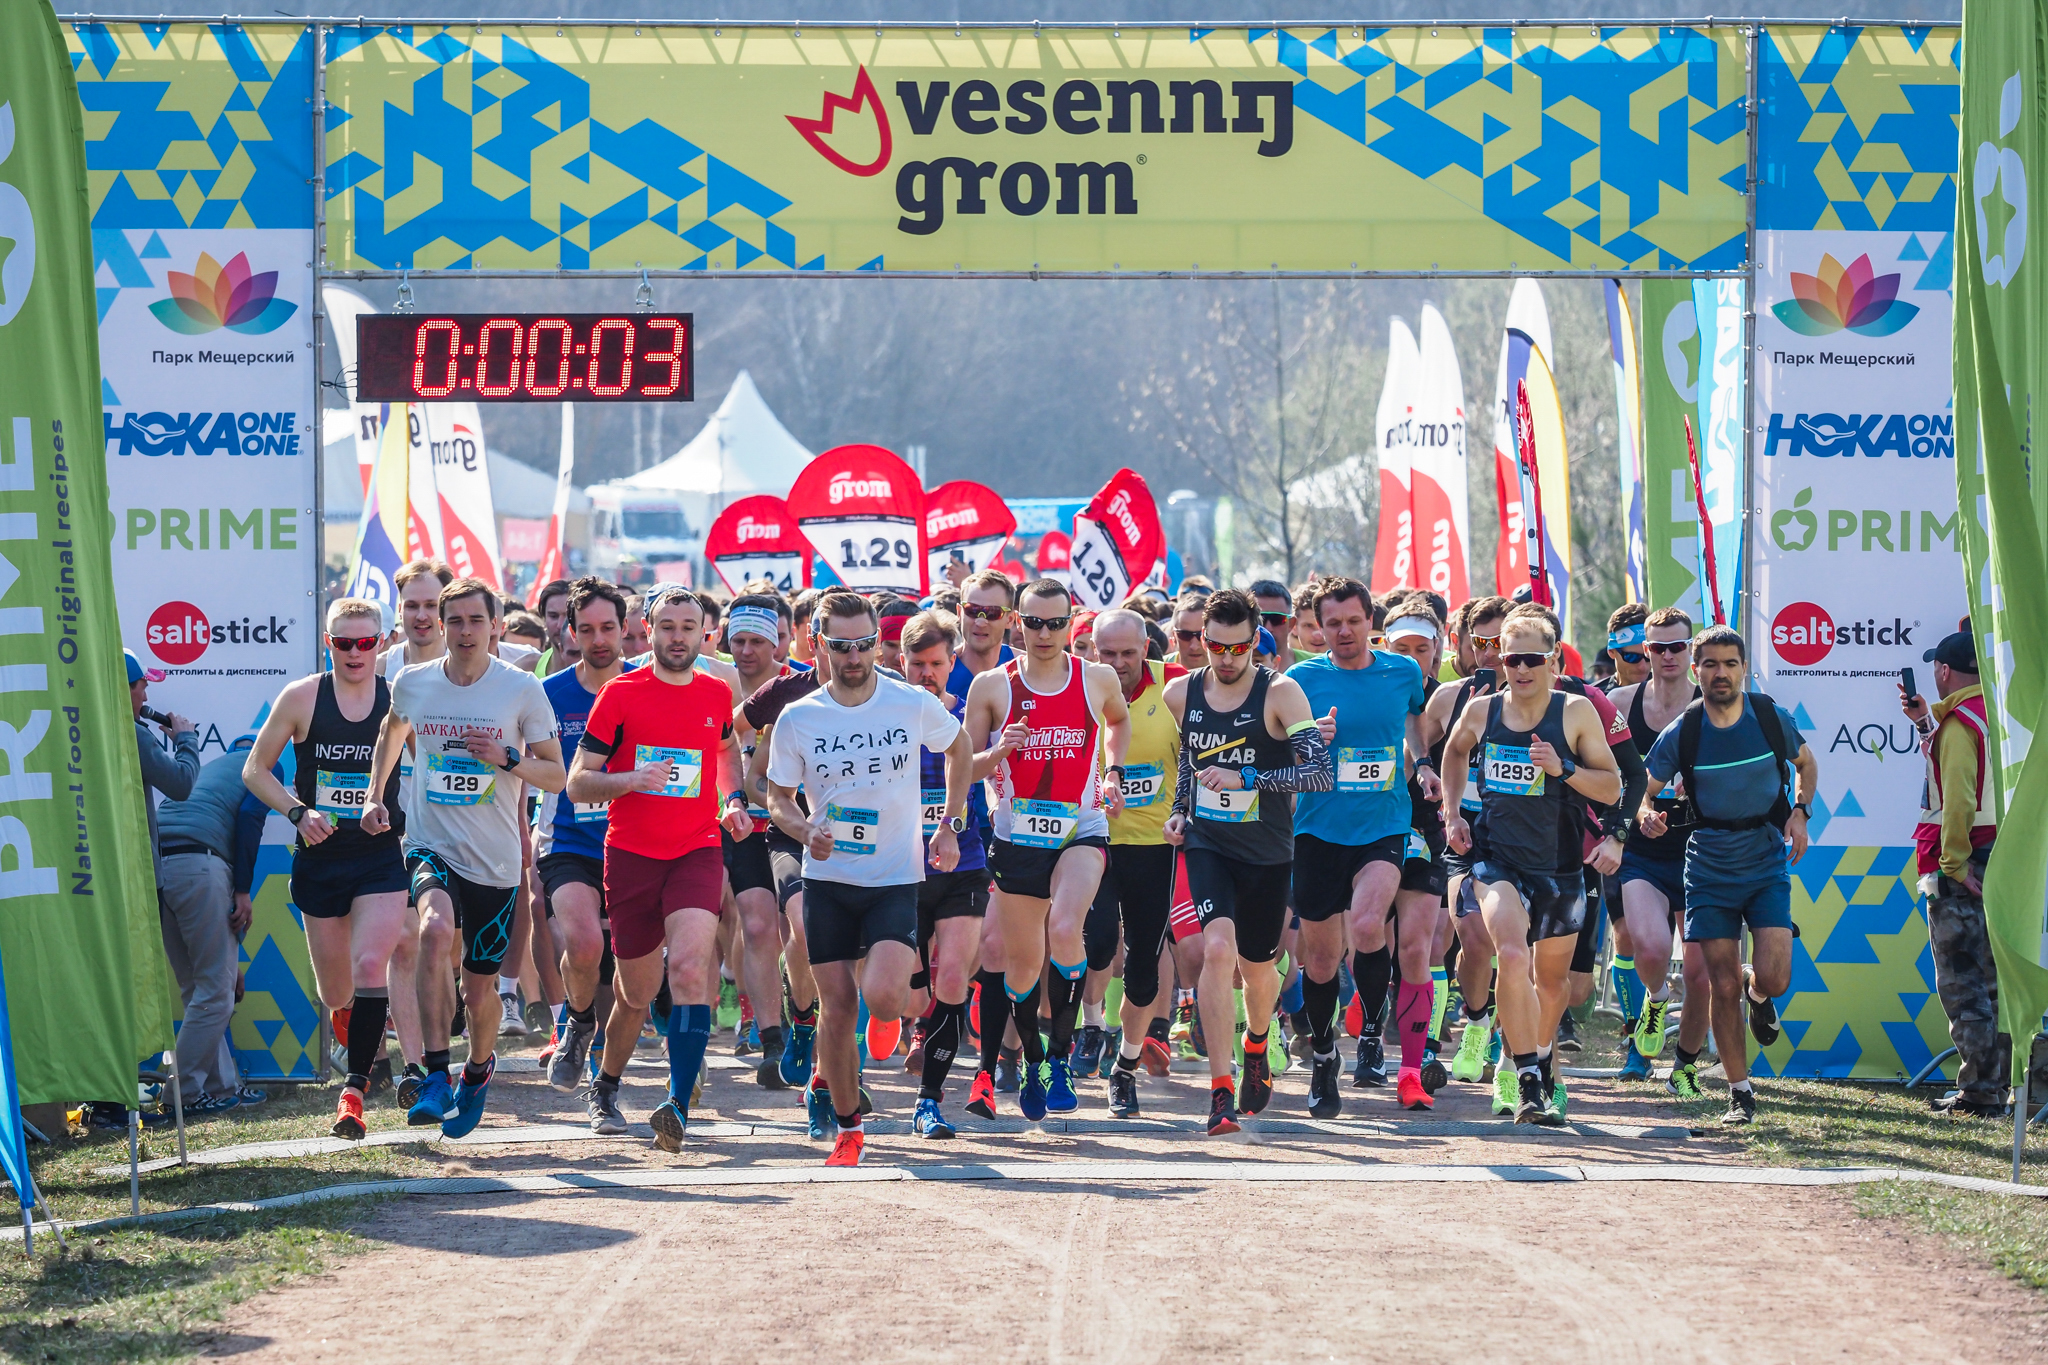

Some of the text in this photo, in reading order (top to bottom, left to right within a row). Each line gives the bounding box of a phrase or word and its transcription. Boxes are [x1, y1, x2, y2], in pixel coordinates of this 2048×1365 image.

[895, 157, 1138, 235] grom
[152, 350, 294, 366] Парк Мещерский
[413, 319, 684, 396] 0:00:03
[1774, 351, 1915, 367] Парк Мещерский
[103, 412, 296, 456] HOKA ONE
[1763, 413, 1954, 458] HOKA ON
[242, 435, 300, 456] ONE
[1910, 436, 1954, 458] ON
[829, 478, 892, 504] grom
[127, 509, 297, 550] PRIME
[926, 508, 980, 538] grom
[1106, 495, 1142, 547] grom
[1828, 509, 1962, 552] PRIM
[841, 537, 912, 569] 1.29
[1072, 541, 1115, 606] 1.29
[49, 418, 94, 897] Natural food Original recipes
[1776, 669, 1841, 677] ЭЛЕКТРОЛИТЫ
[1850, 669, 1902, 678] ДИСПЕНСЕР
[1189, 709, 1203, 723] AG
[814, 728, 908, 754] RACING
[1053, 729, 1085, 746] Class
[1189, 731, 1227, 749] RUN
[316, 743, 376, 760] INSPIR
[1024, 749, 1076, 760] RUSSIA
[1218, 748, 1256, 764] LAB
[816, 754, 908, 779] CREW
[1358, 764, 1380, 779] 26
[1492, 763, 1535, 781] 1293
[442, 774, 479, 791] 129
[330, 789, 366, 805] 496
[1219, 793, 1230, 808] 5
[853, 825, 865, 840] 6
[1027, 817, 1062, 834] 130
[1197, 899, 1214, 921] AG
